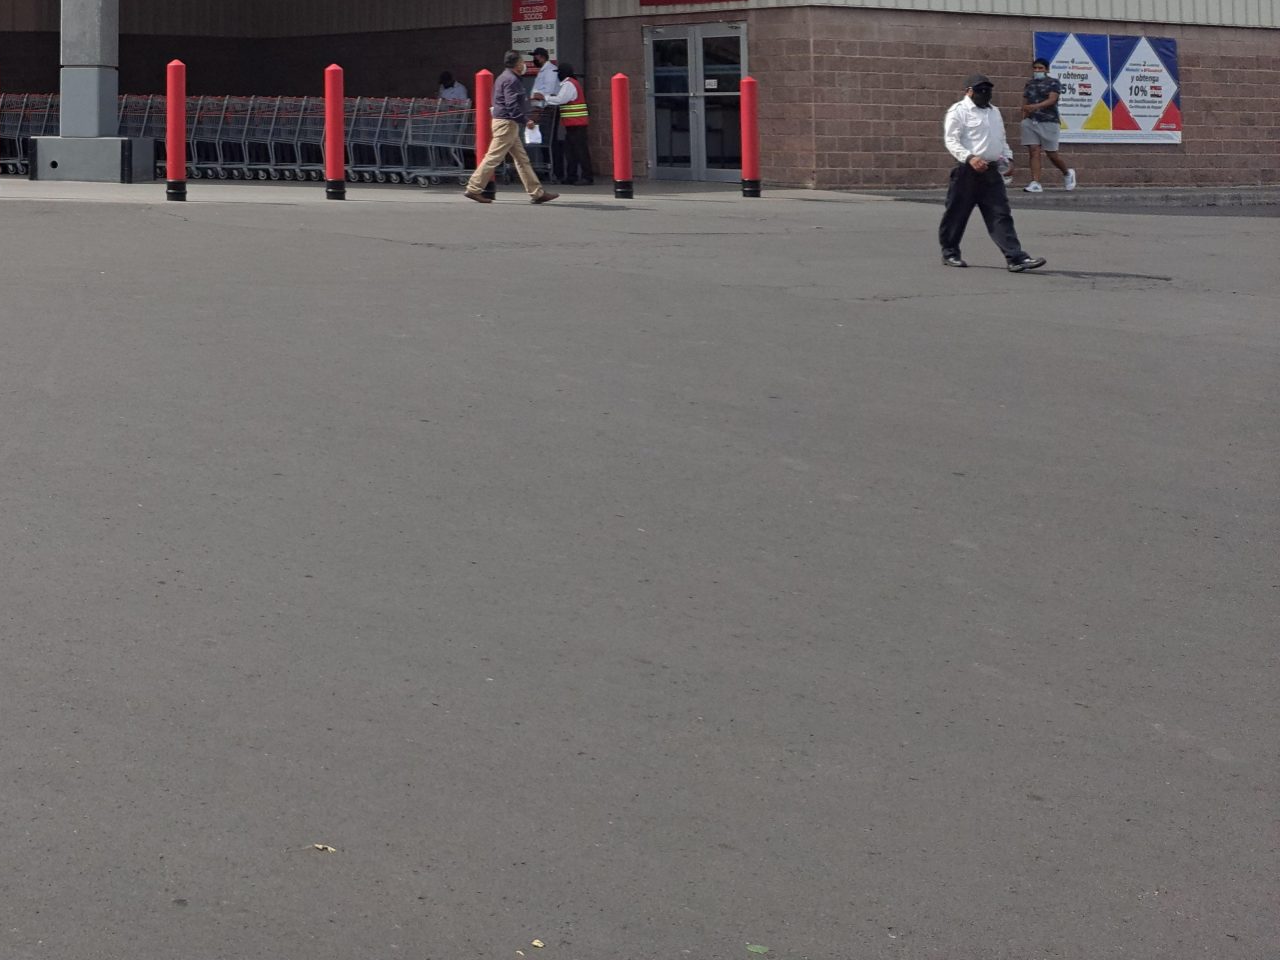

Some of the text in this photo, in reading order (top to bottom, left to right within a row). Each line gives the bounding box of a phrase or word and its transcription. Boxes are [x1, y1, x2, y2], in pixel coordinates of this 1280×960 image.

[1063, 71, 1089, 81] obtenga
[1135, 74, 1160, 83] obtenga
[1129, 85, 1148, 97] 10%
